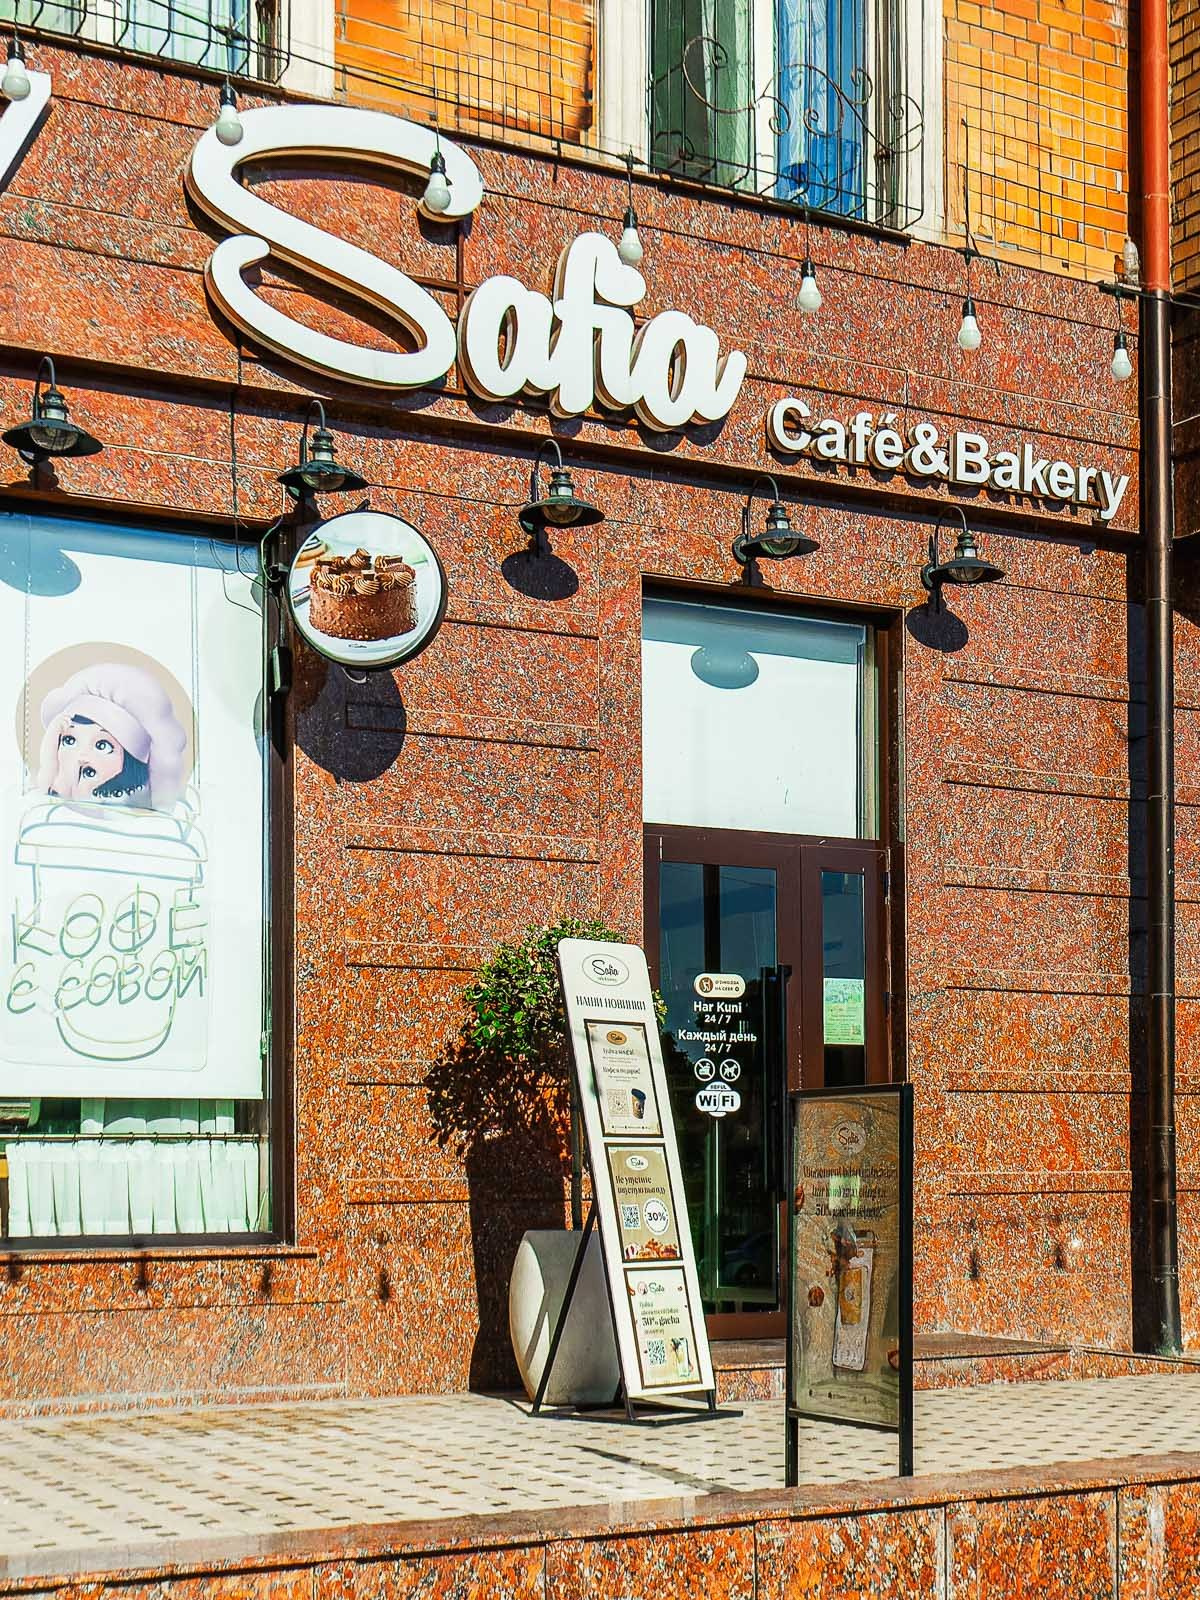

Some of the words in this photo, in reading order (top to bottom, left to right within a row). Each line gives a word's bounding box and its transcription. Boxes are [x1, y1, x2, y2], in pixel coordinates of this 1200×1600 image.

[184, 104, 747, 431] Safia
[693, 1001, 714, 1012] Har
[716, 1001, 742, 1013] Kuni
[678, 1029, 727, 1043] Каждый
[729, 1032, 757, 1043] день
[647, 1212, 666, 1221] 30%
